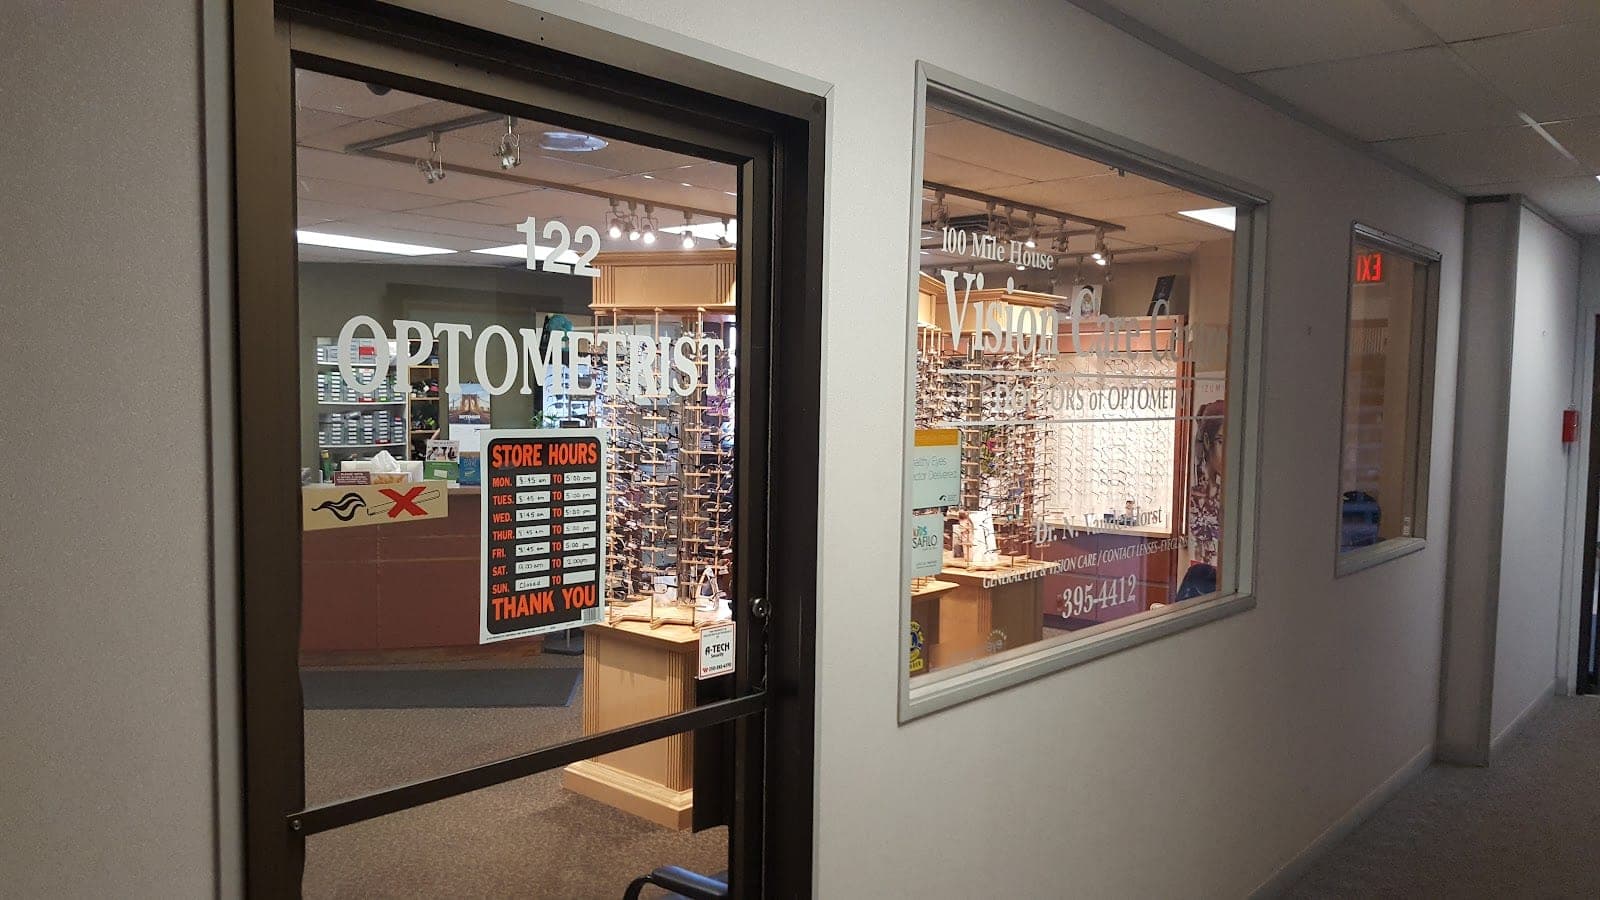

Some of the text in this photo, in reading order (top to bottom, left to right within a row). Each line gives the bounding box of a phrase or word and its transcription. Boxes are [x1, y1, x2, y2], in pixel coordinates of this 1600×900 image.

[516, 216, 602, 278] 122
[940, 227, 1054, 271] 100 Mile House
[940, 269, 1059, 357] Vision
[1071, 287, 1140, 362] Care
[336, 314, 725, 397] OPTOMETRIST
[1088, 388, 1104, 410] of
[492, 442, 598, 468] STORE HOURS
[492, 476, 512, 487] MON.
[552, 474, 562, 484] TO
[492, 495, 514, 505] TUES.
[552, 491, 562, 500] TO
[493, 513, 512, 523] WED.
[552, 508, 562, 518] TO
[493, 530, 515, 540] THUR.
[552, 525, 562, 535] TO
[912, 534, 938, 549] SAFILO
[1034, 520, 1058, 545] Dr.
[1062, 515, 1079, 540] N.
[492, 548, 506, 559] FRI.
[552, 542, 562, 552] TO
[492, 566, 508, 577] SAT.
[552, 559, 562, 568] TO
[983, 570, 1022, 589] GENERAL
[1048, 556, 1076, 575] VISION
[1077, 553, 1097, 570] CARE
[1103, 546, 1136, 565] CONTACT
[492, 583, 510, 594] SUN.
[552, 576, 562, 585] TO
[1061, 574, 1136, 620] 395-4412
[492, 584, 596, 621] THANK YOU
